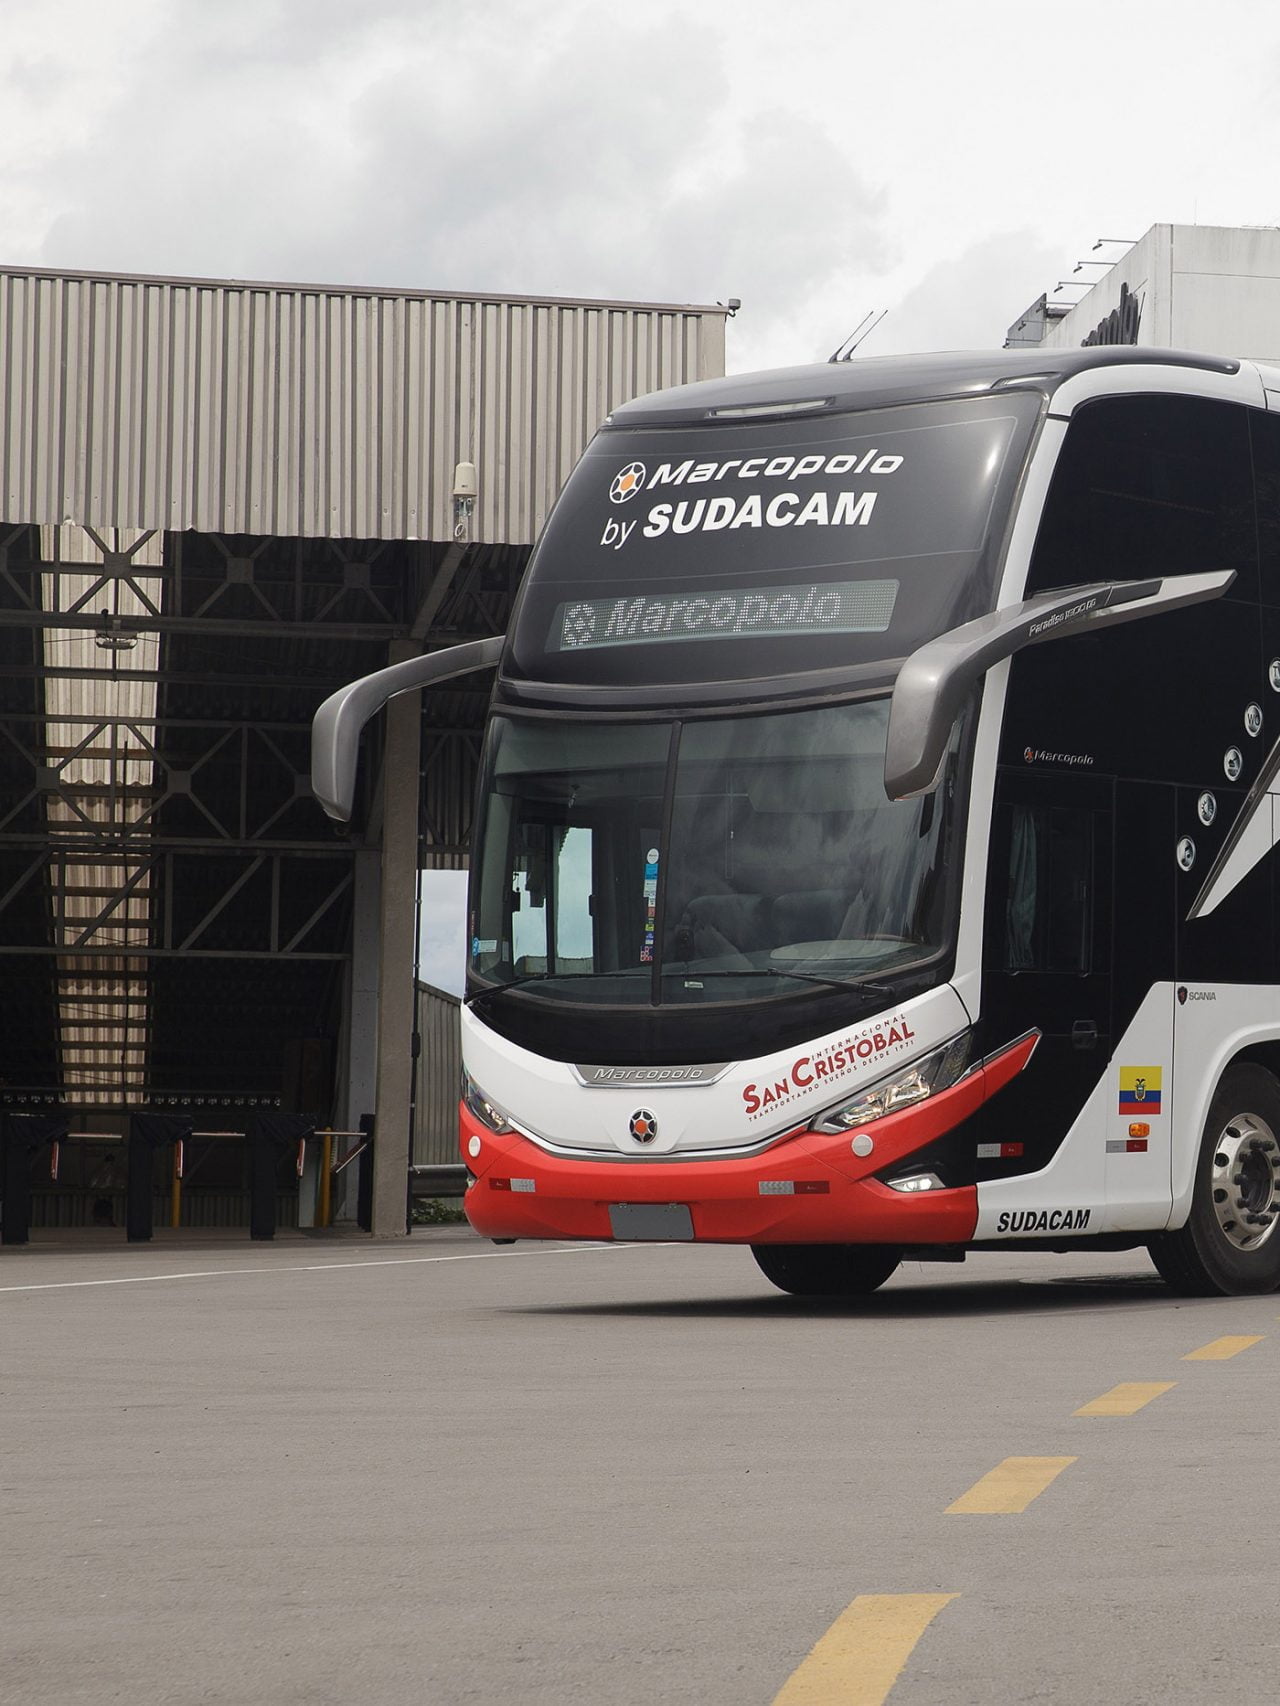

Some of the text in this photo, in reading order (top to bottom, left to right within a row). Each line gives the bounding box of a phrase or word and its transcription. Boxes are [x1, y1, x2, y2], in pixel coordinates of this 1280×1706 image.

[646, 449, 904, 489] Marcopolo
[600, 492, 878, 550] by SUDACAM
[604, 587, 842, 637] Marcopolo
[1034, 750, 1094, 765] Marcopolo
[1188, 991, 1217, 1001] SCANIA
[811, 1013, 907, 1062] INTERNACIONAL
[593, 1066, 704, 1082] Marcopolo
[742, 1021, 915, 1114] SAN CRISTOBAL
[748, 1040, 915, 1122] TRANSPORTANDO SUEÑOS DESDE 1971
[997, 1209, 1091, 1232] SUDACAM
